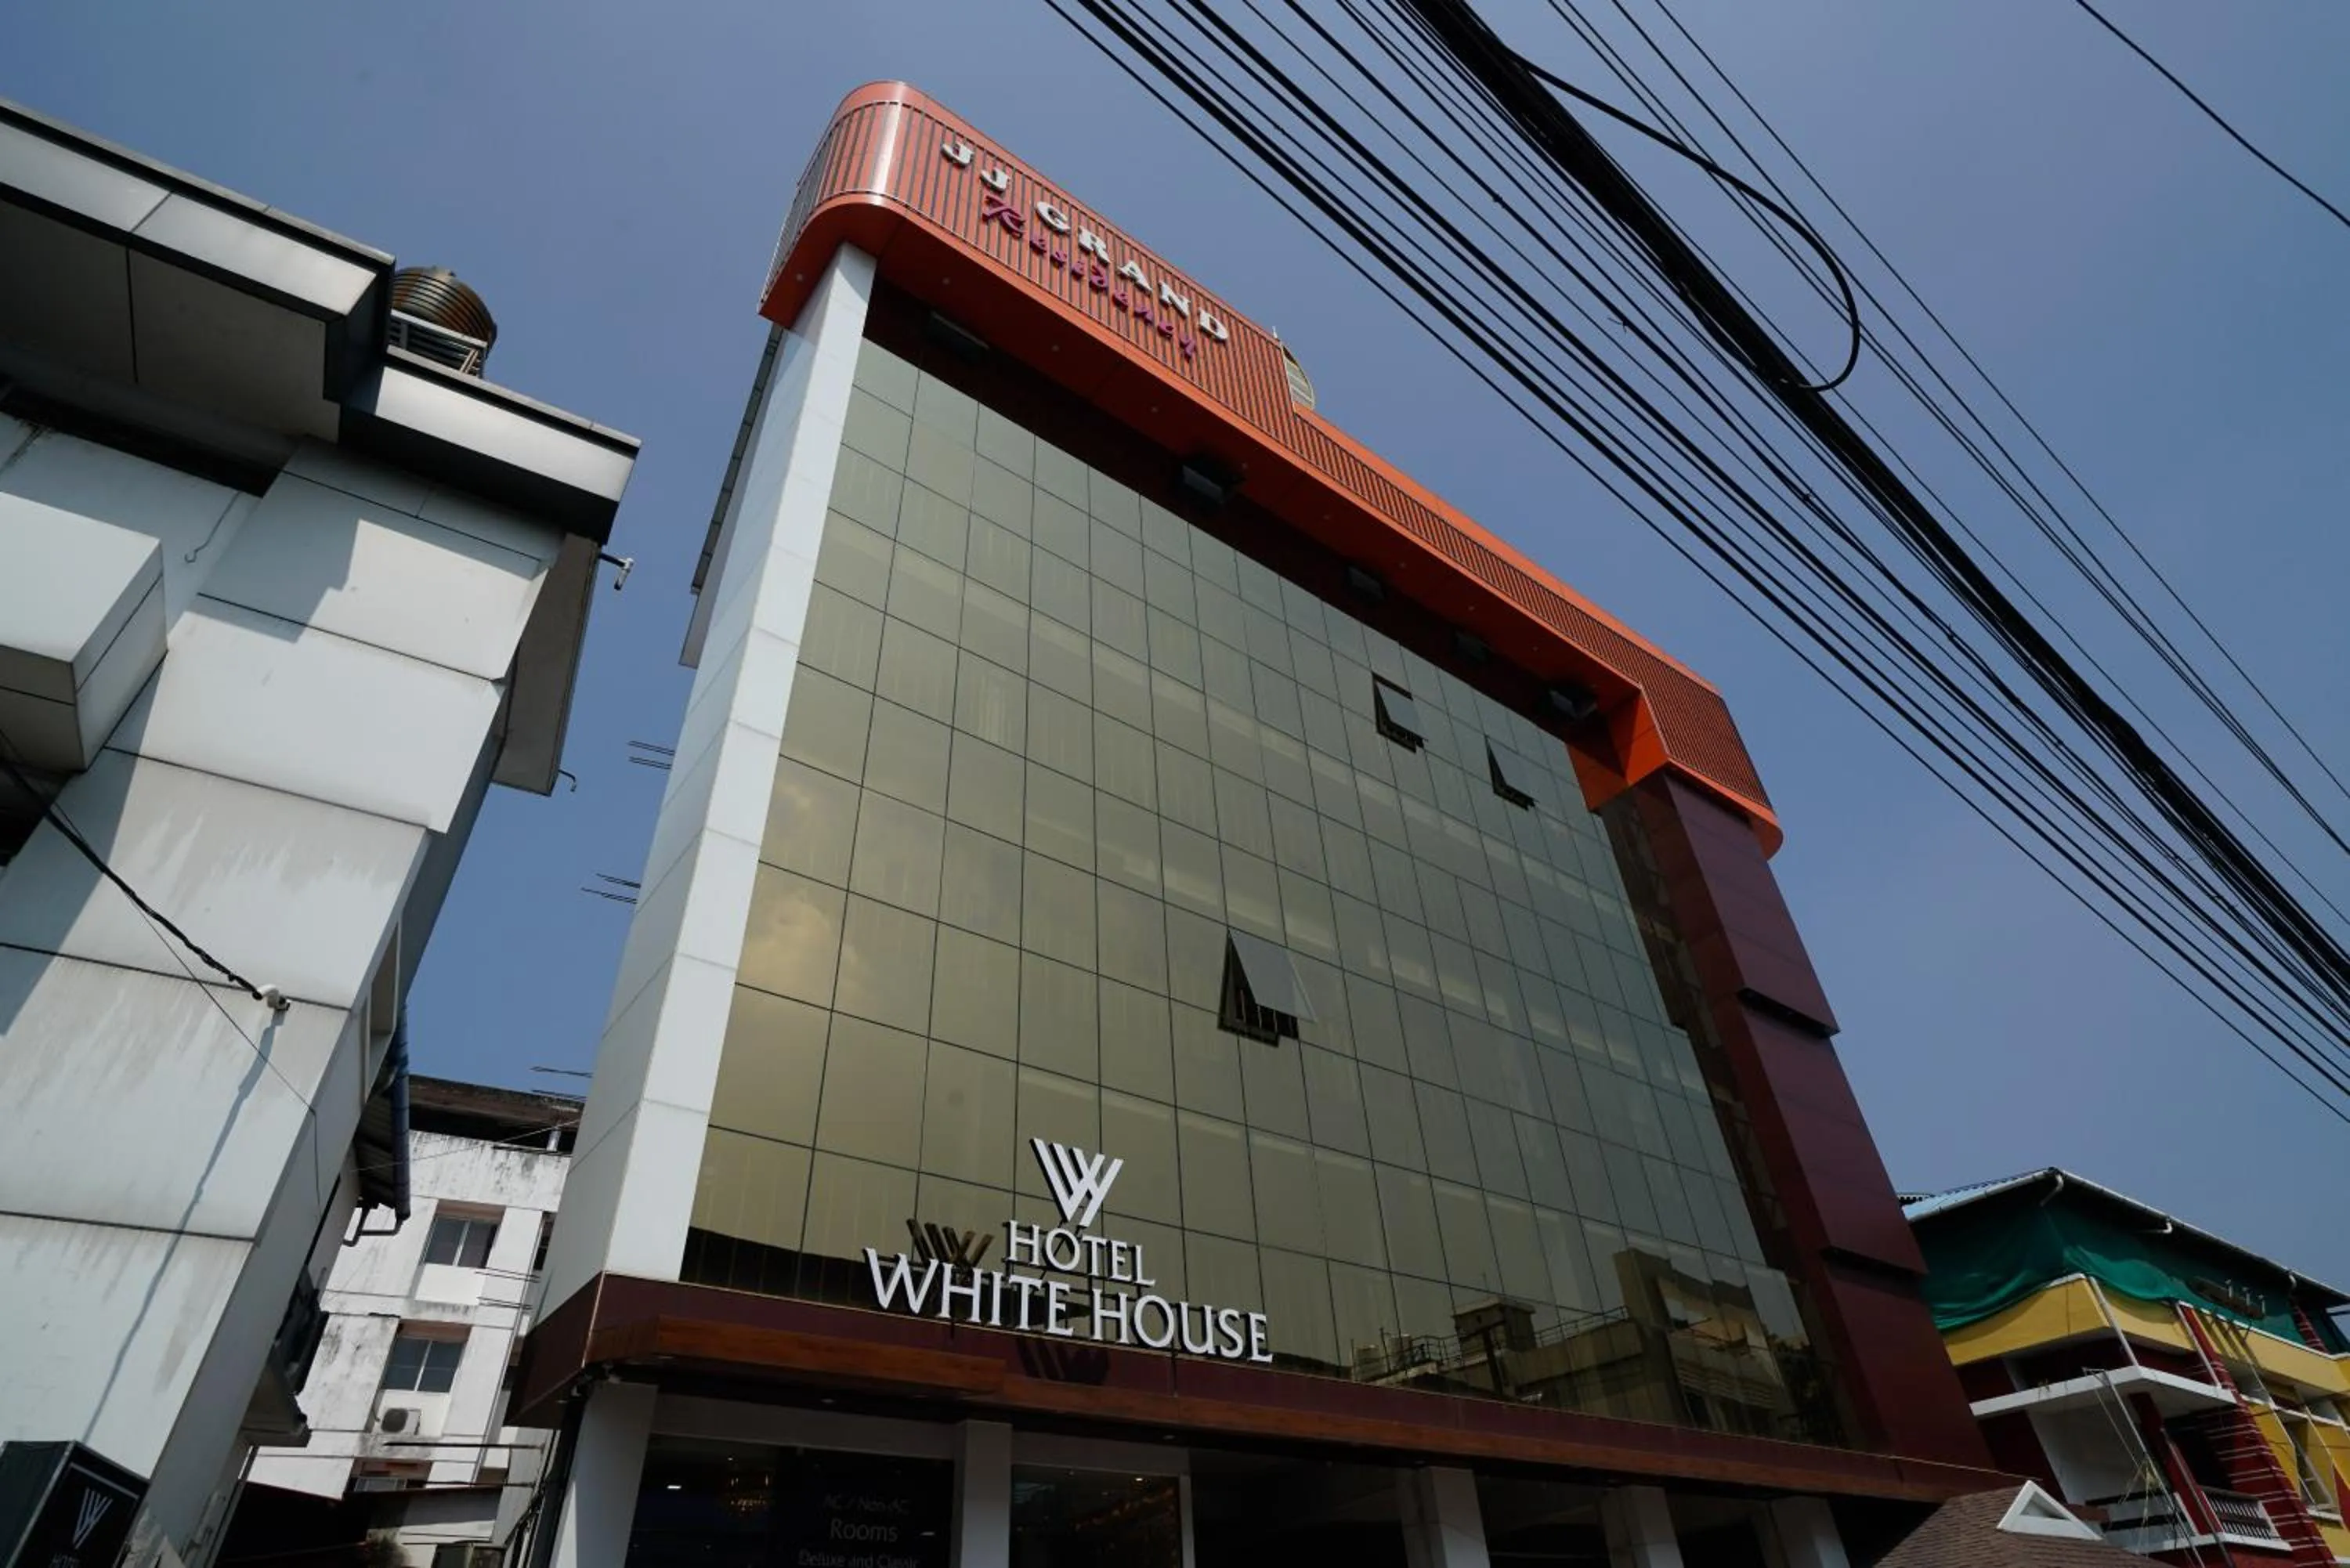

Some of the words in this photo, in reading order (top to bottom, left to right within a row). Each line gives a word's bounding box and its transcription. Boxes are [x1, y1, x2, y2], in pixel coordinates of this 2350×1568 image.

[1035, 201, 1230, 342] GRAND
[1006, 1219, 1156, 1287] HOTEL
[862, 1247, 1075, 1336] WHITE
[1092, 1288, 1273, 1363] HOUSE
[830, 1518, 898, 1542] Rooms
